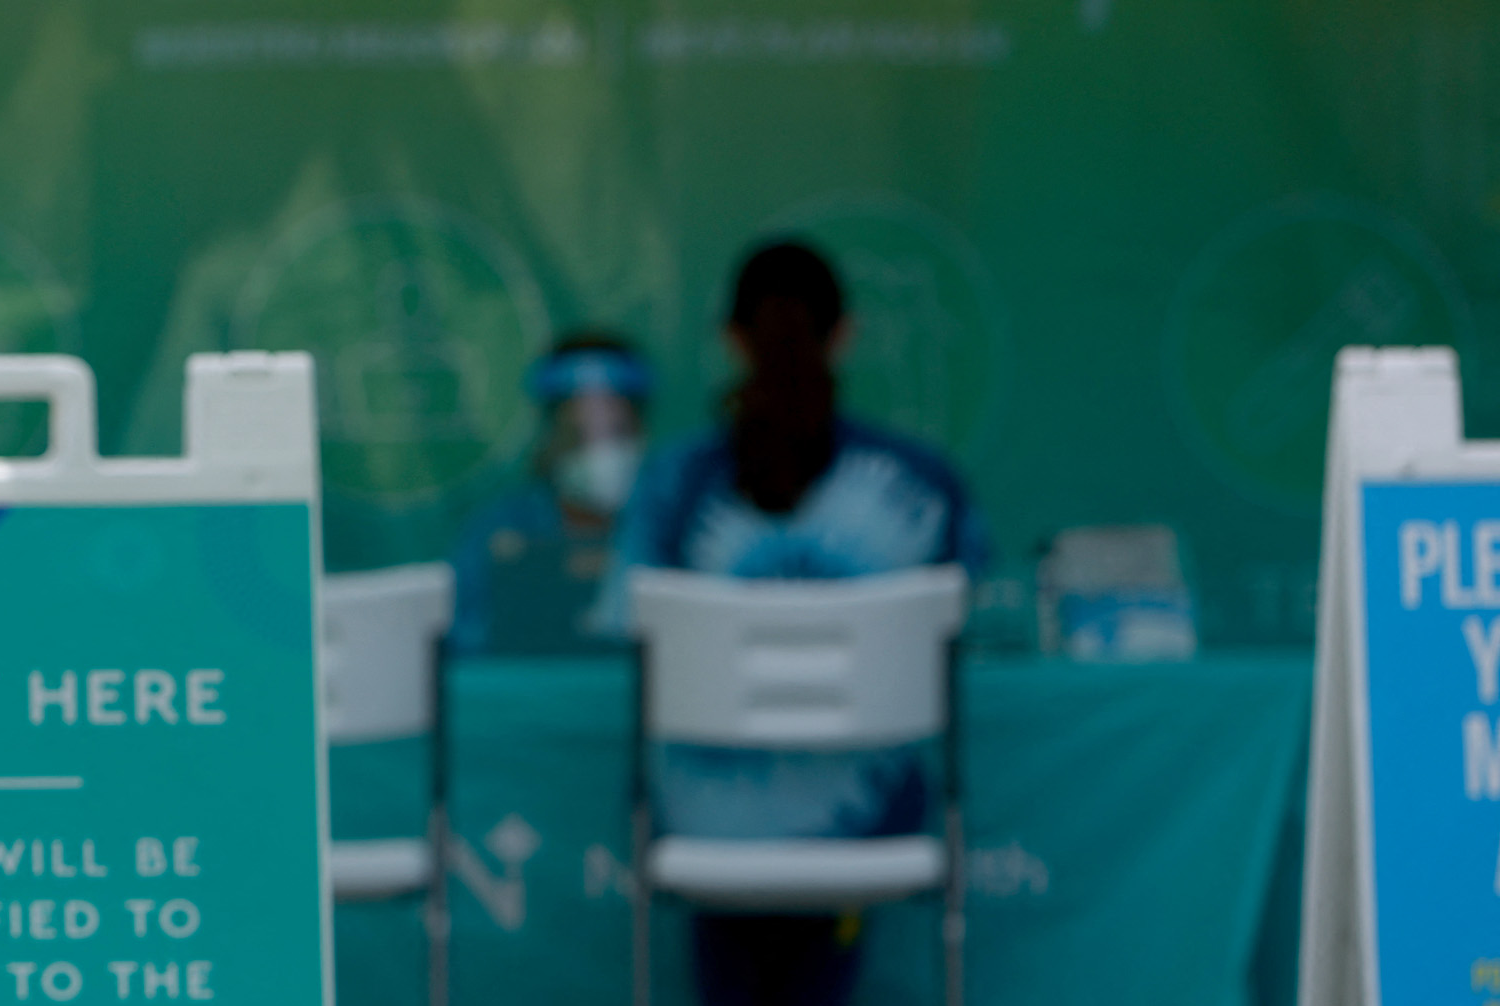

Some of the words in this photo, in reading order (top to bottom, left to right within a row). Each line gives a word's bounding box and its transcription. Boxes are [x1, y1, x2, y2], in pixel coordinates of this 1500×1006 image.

[28, 668, 227, 726] HERE
[134, 835, 201, 878] BE
[124, 897, 202, 940] TO
[6, 960, 85, 1003] TO
[108, 959, 214, 1001] THE
